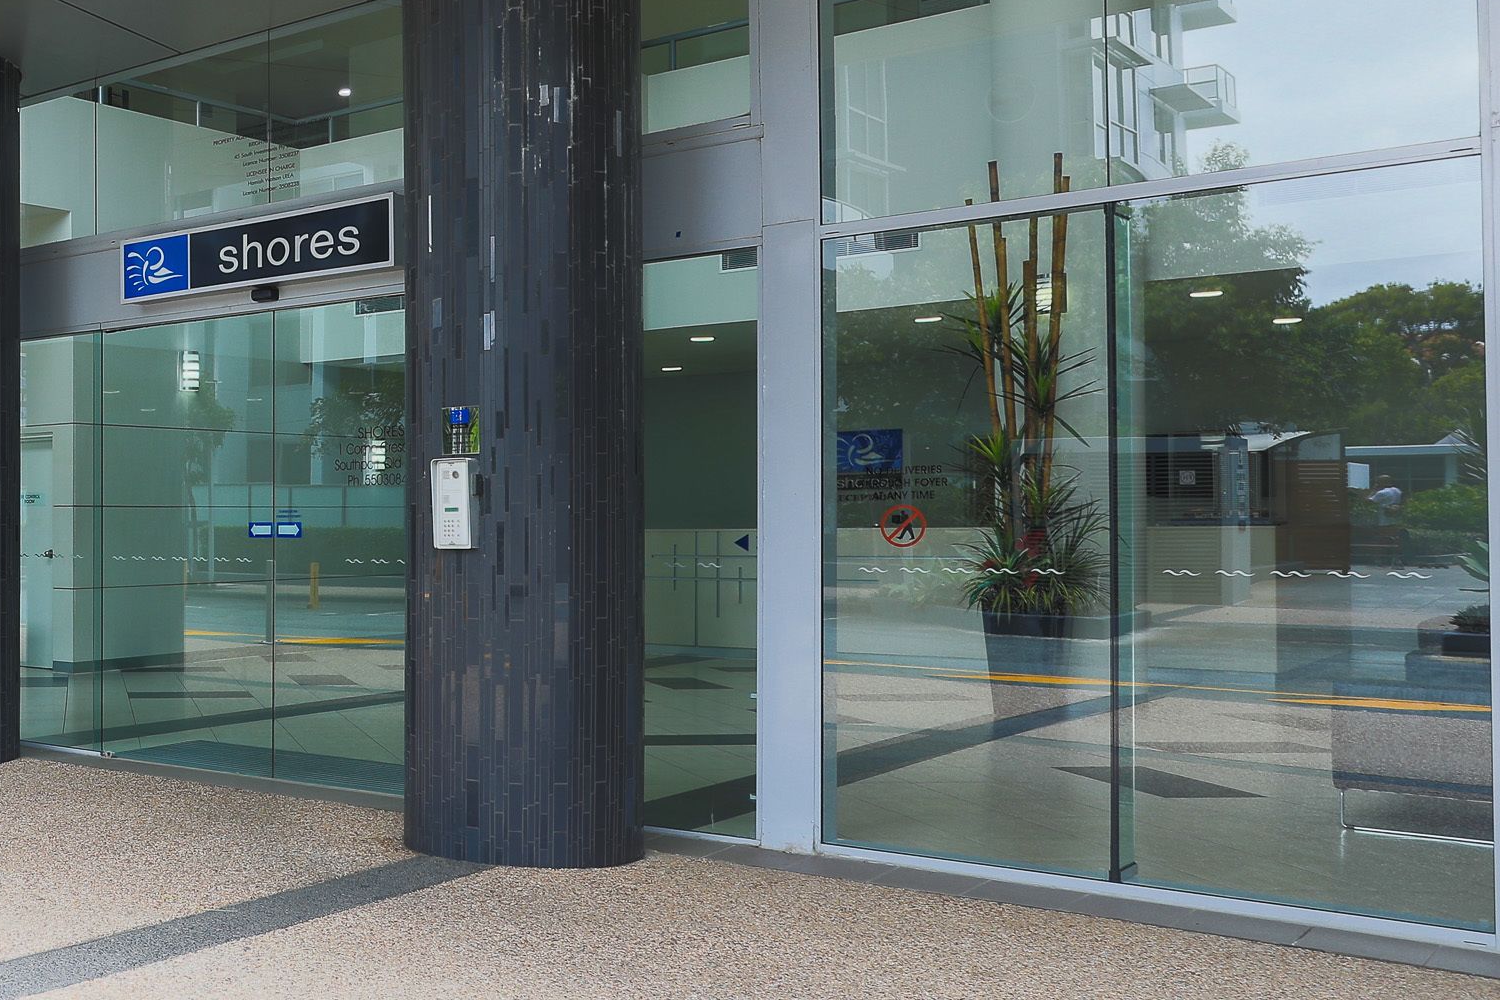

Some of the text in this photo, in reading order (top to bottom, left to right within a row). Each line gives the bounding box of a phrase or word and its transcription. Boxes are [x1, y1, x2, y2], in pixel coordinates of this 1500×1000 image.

[274, 162, 296, 173] CHARGE
[217, 225, 361, 275] shores
[358, 425, 405, 439] SHORES
[334, 458, 381, 472] Southpo
[914, 477, 948, 487] FOYER
[910, 489, 936, 500] TIME
